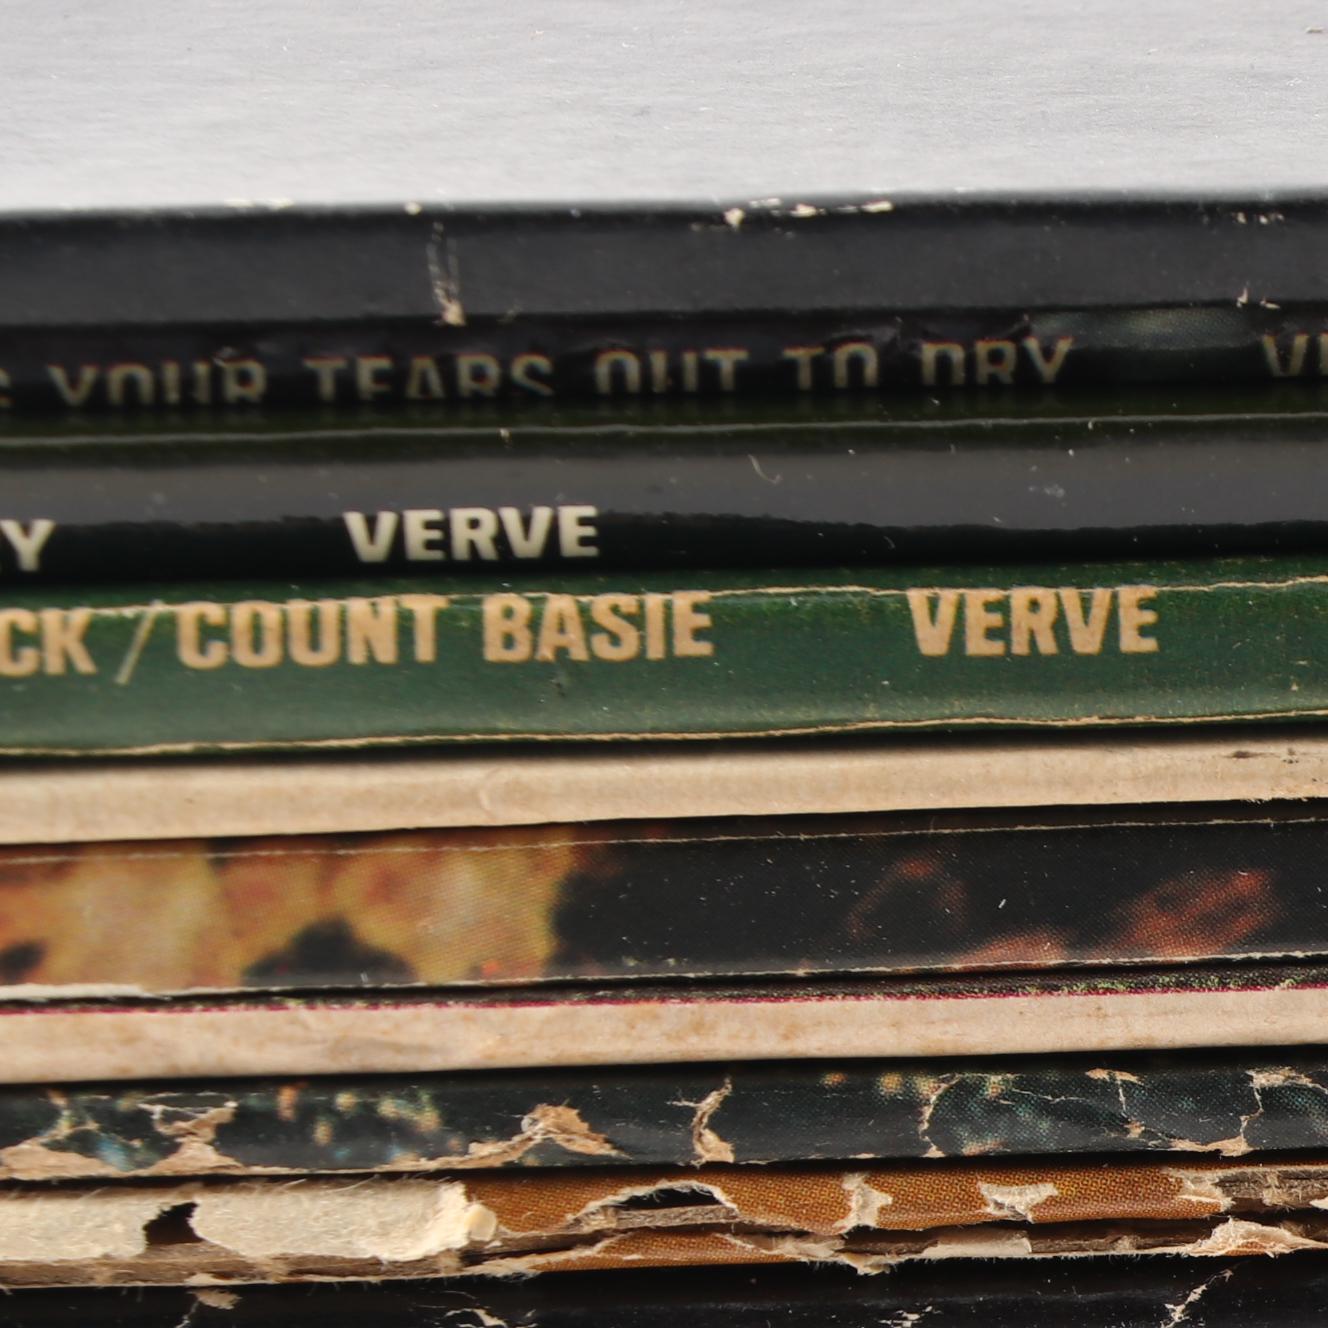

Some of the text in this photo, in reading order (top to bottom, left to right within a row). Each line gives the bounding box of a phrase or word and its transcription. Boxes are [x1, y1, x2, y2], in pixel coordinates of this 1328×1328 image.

[48, 357, 265, 405] YOUR
[303, 351, 553, 402] TEARS
[595, 348, 749, 396] OUT
[783, 343, 879, 389] TO
[921, 337, 1074, 387] DRY
[1, 504, 599, 573] Y VERVE
[482, 590, 715, 662] BASIE
[906, 584, 1159, 657] VERVE
